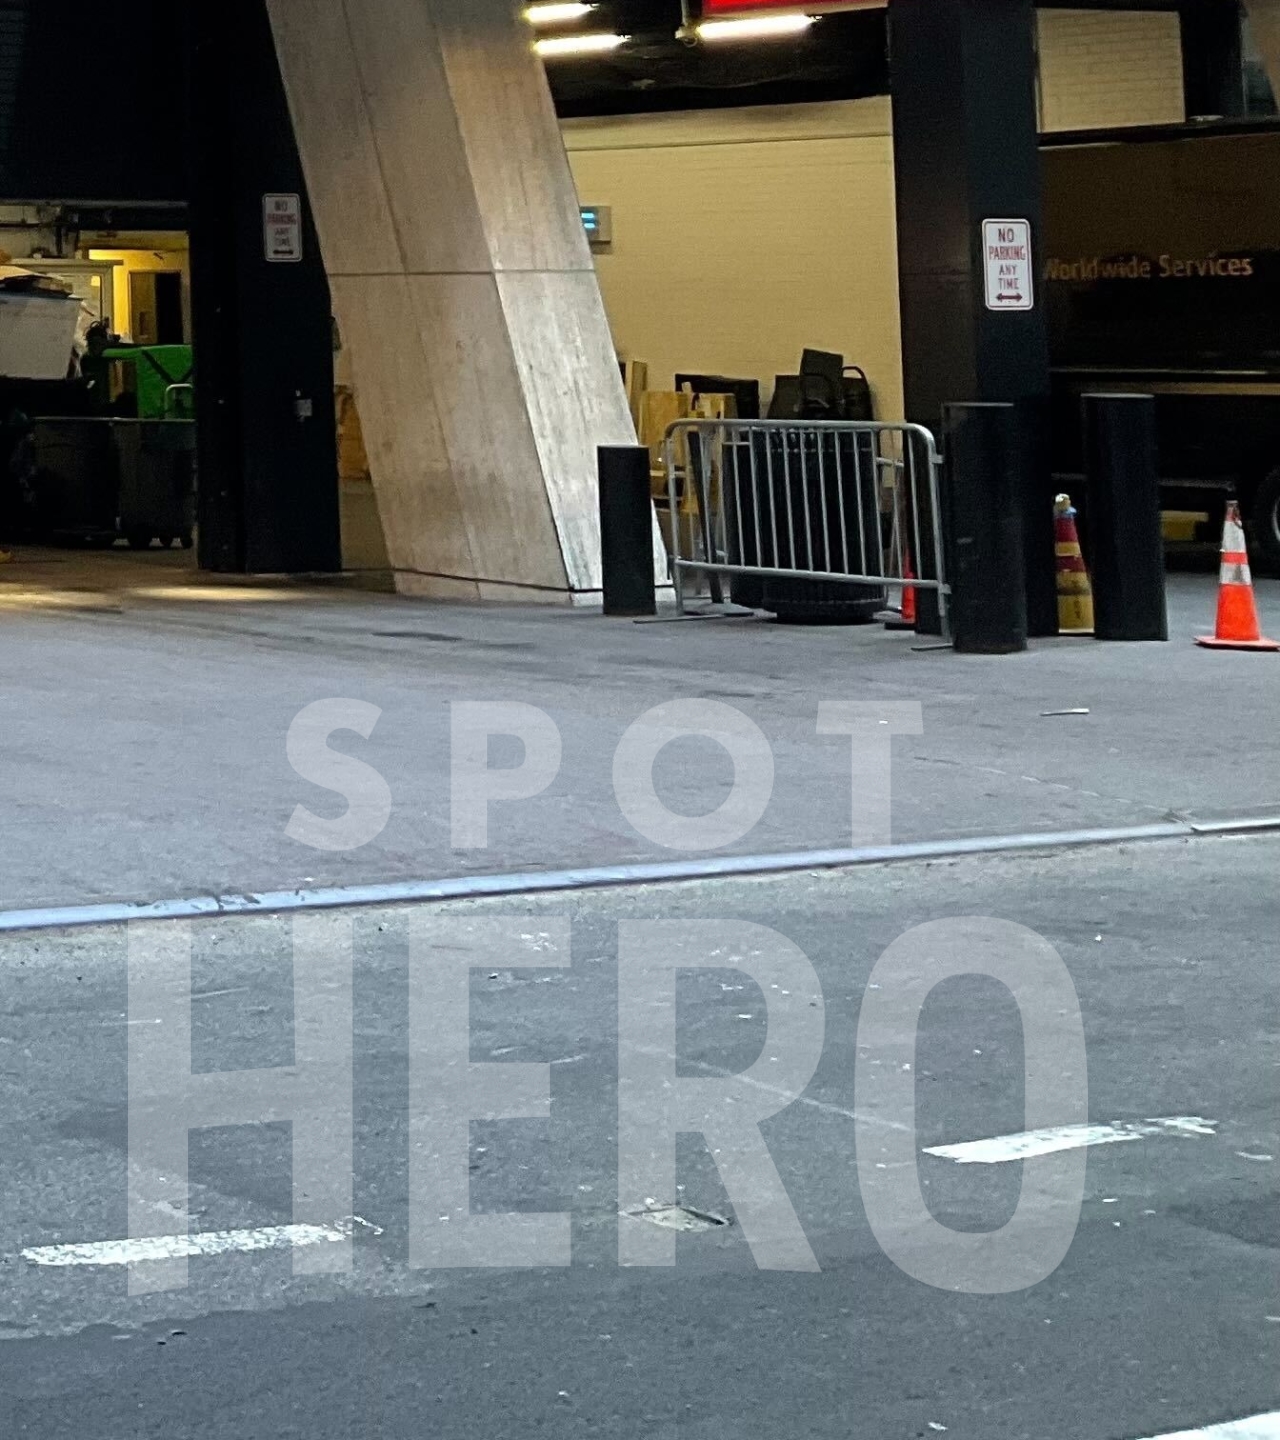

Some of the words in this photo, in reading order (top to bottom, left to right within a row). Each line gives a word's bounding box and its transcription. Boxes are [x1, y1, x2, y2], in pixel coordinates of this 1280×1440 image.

[998, 228, 1014, 242] NO
[988, 245, 1026, 261] PARKING
[999, 264, 1017, 276] ANY
[1158, 254, 1254, 277] Services
[998, 277, 1020, 290] TIME
